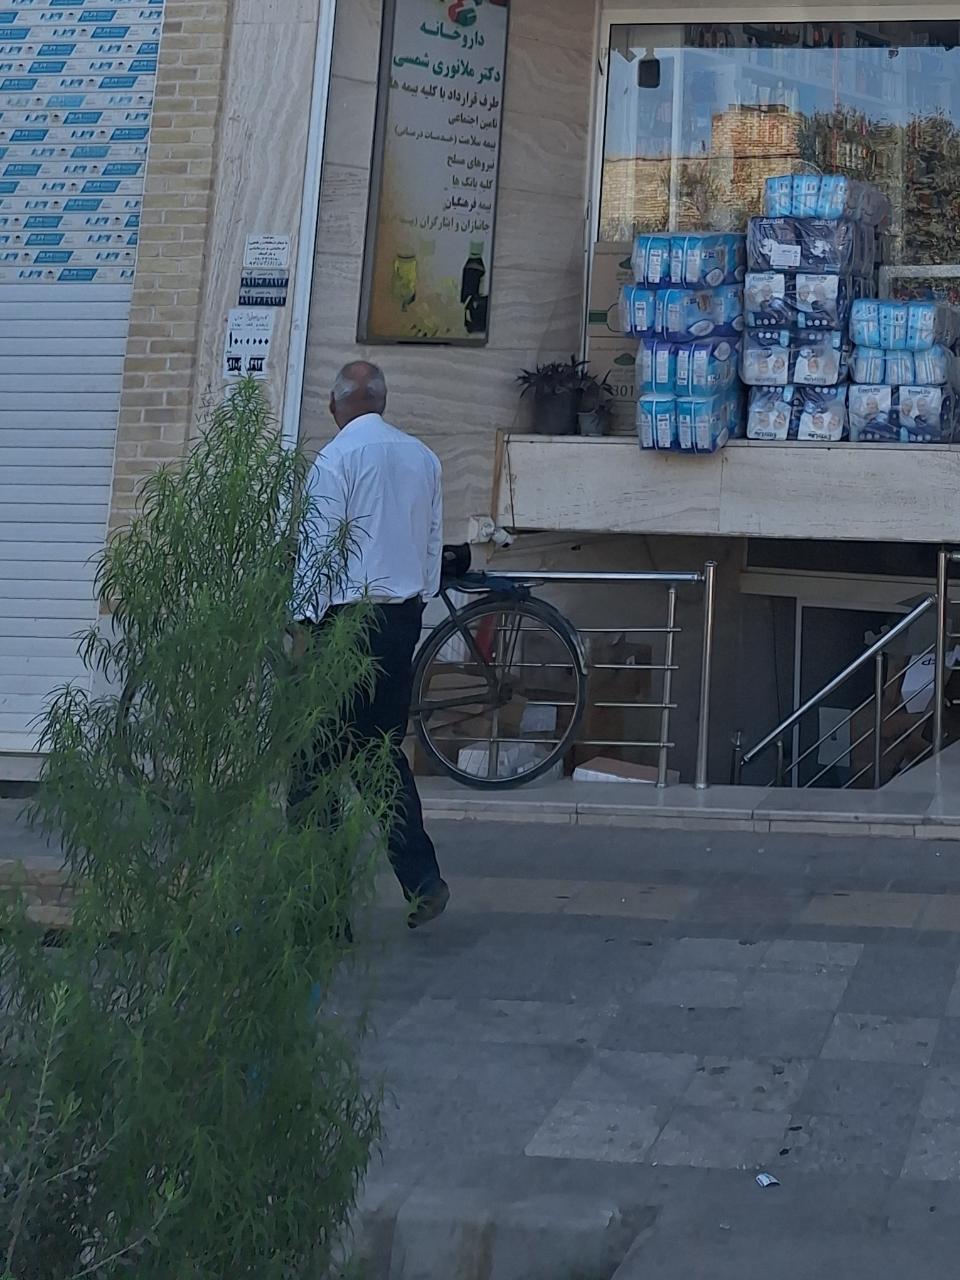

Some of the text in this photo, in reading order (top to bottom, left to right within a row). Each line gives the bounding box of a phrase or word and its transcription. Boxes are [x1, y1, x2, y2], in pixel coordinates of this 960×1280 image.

[420, 21, 484, 49] داروخانه
[393, 52, 500, 84] دکتر ملانوری شمسی
[402, 84, 418, 96] بیمه
[420, 85, 438, 99] کلیه
[440, 88, 446, 102] با
[448, 89, 477, 108] قرارداد
[480, 97, 499, 110] طرف
[448, 113, 478, 127] اجتماعی
[459, 134, 481, 147] سلامت
[483, 140, 496, 151] بیمه
[447, 154, 494, 172] نیروهای مسلح
[480, 179, 493, 192] کلیه
[445, 196, 476, 212] فرهنگیان
[461, 219, 490, 233] جانبازان
